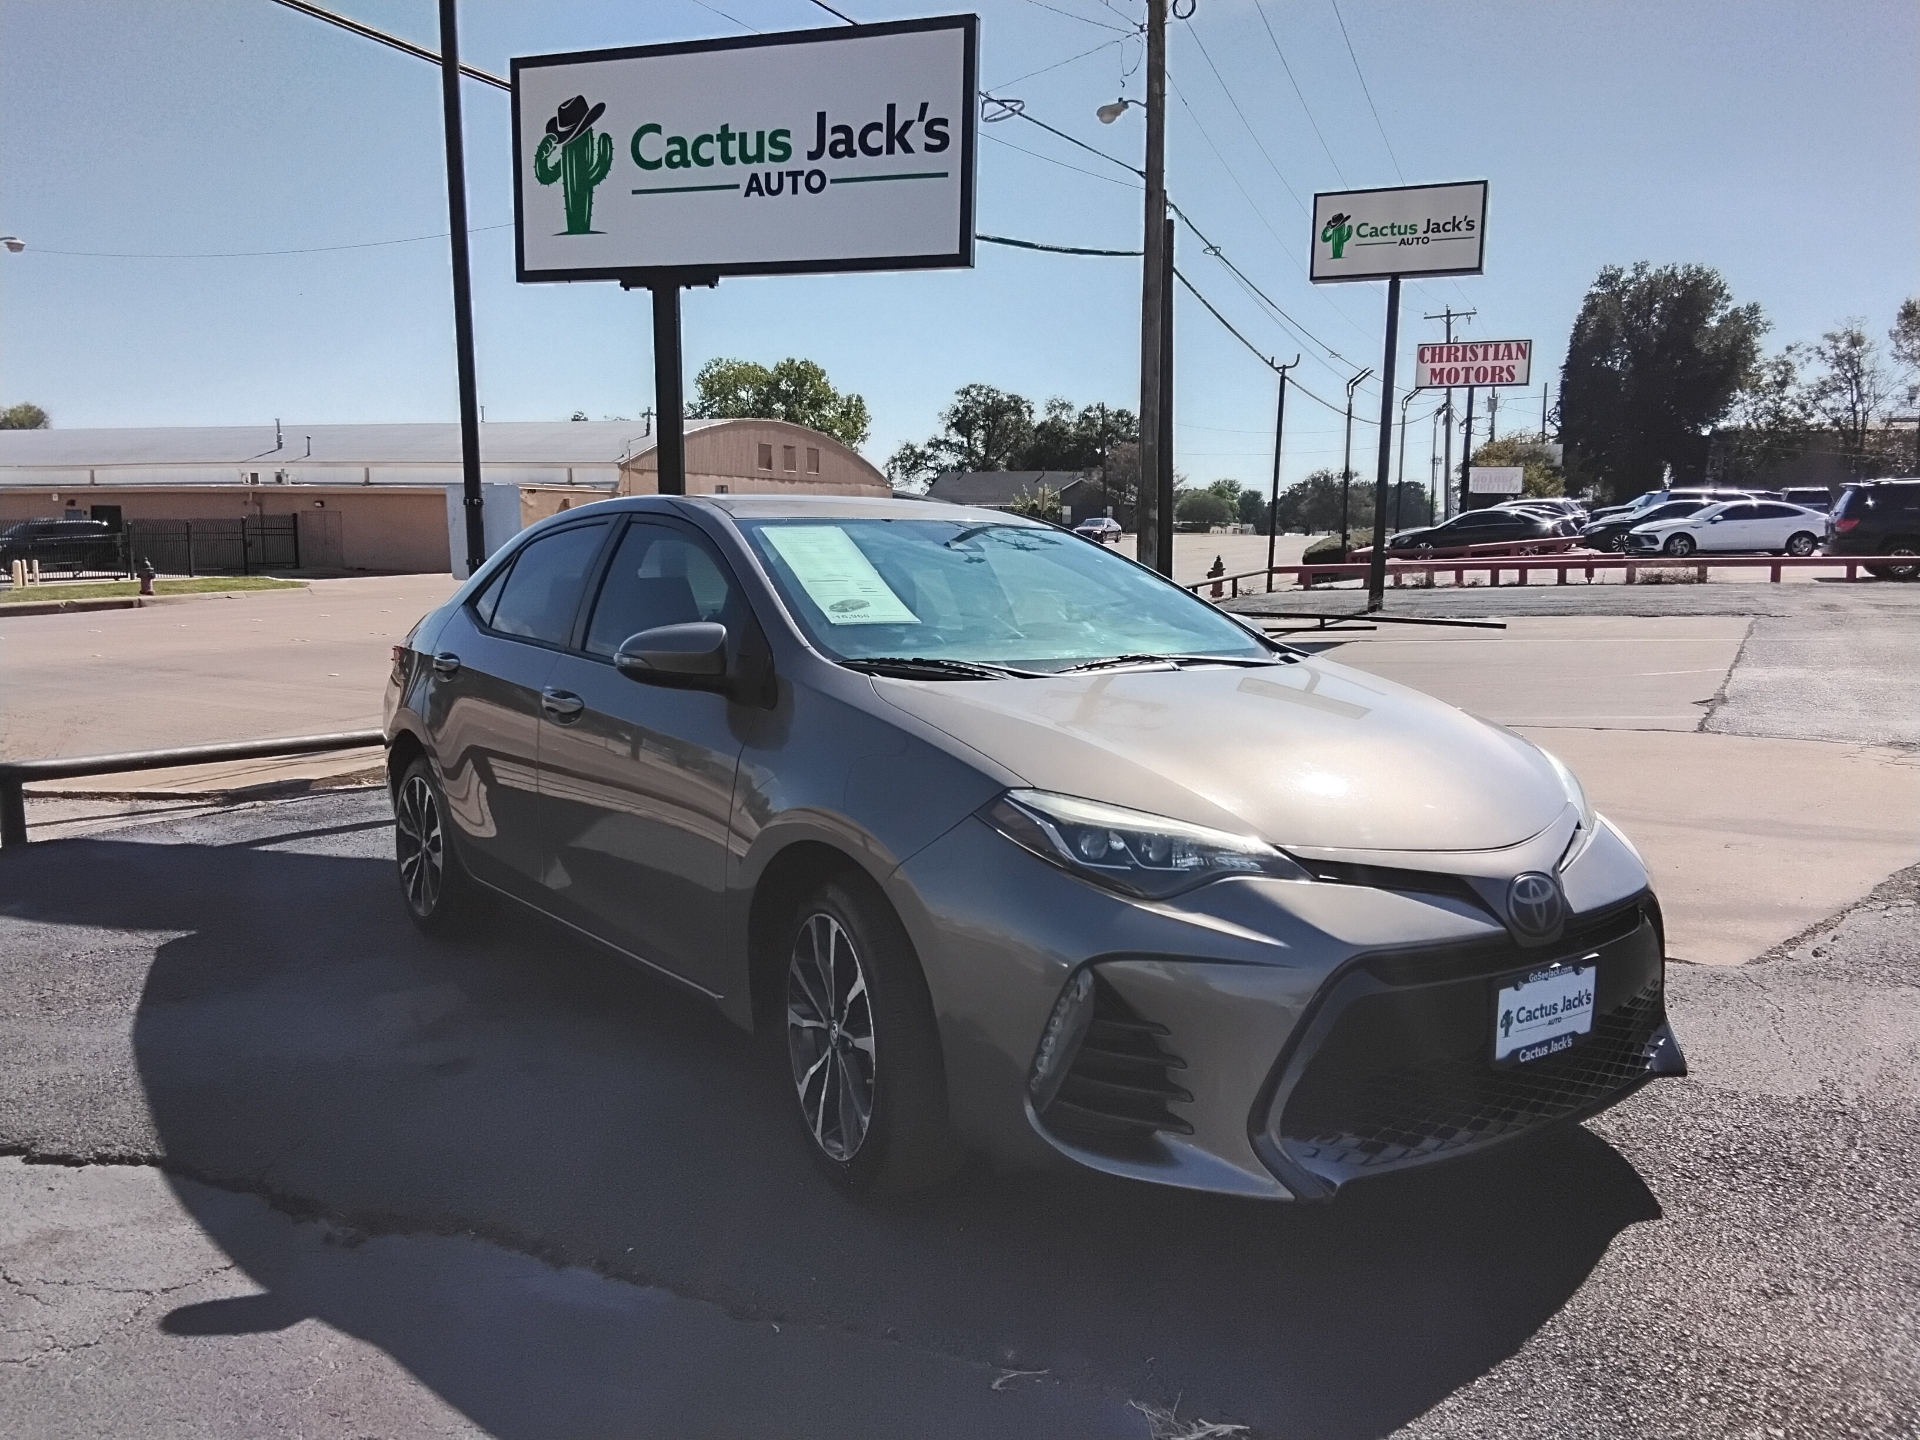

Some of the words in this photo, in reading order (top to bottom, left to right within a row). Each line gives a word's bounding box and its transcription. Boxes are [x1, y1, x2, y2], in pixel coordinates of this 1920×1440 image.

[630, 123, 793, 171] Cactus
[806, 102, 950, 161] Jack's
[744, 169, 827, 198] AUTO
[1356, 222, 1418, 239] Cactus
[1422, 215, 1475, 234] Jack's
[1398, 236, 1430, 247] AUTO
[1418, 342, 1529, 364] CHRISTIAN
[1429, 364, 1516, 385] MOTORS
[1516, 1002, 1558, 1024] Cactus
[1561, 989, 1592, 1013] Jack's
[1547, 1016, 1562, 1027] AUTO
[1519, 1045, 1548, 1063] Cactus
[1549, 1036, 1573, 1054] Jack's
